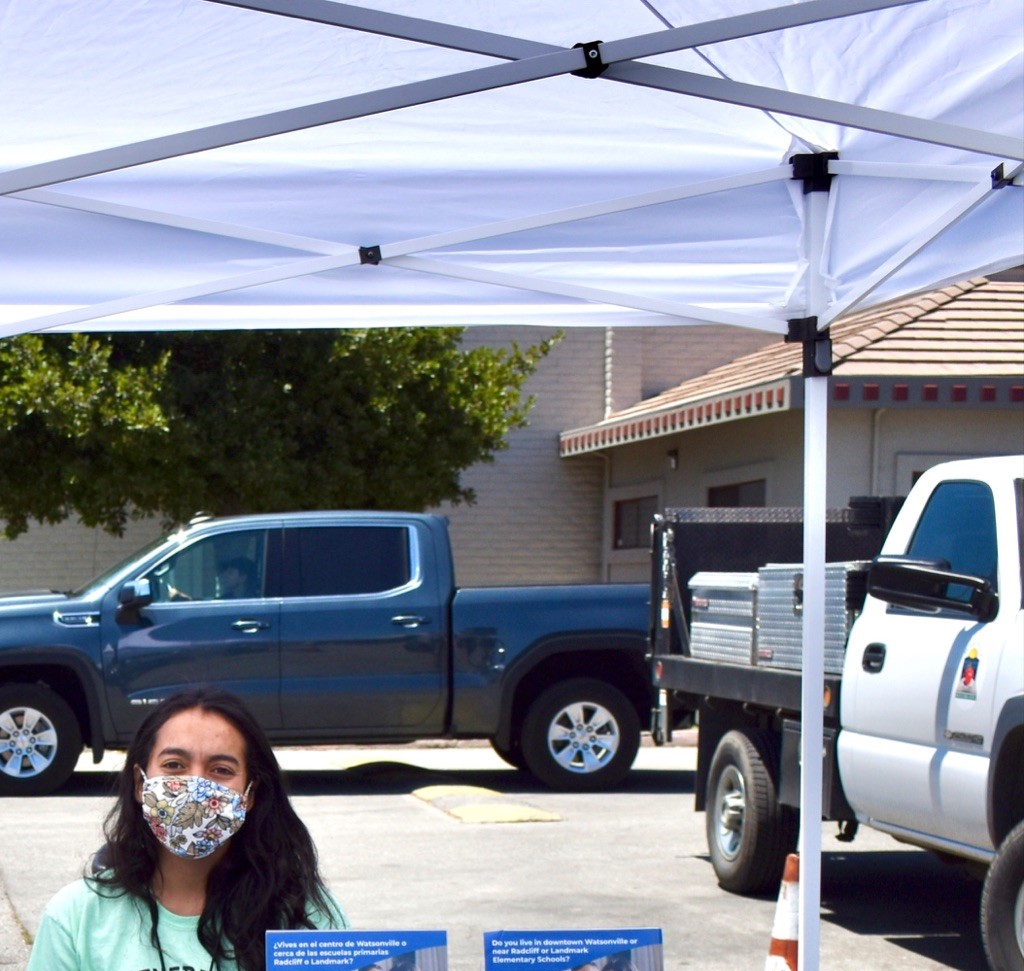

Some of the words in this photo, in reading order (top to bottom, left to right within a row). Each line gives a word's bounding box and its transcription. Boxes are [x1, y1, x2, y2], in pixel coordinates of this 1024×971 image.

[274, 941, 297, 949] ¿Vives
[356, 939, 400, 947] Watsonville
[492, 939, 503, 947] Do
[543, 938, 583, 946] downtown
[353, 948, 389, 957] primarias
[511, 947, 539, 955] Radcliff
[493, 956, 535, 965] Elementary
